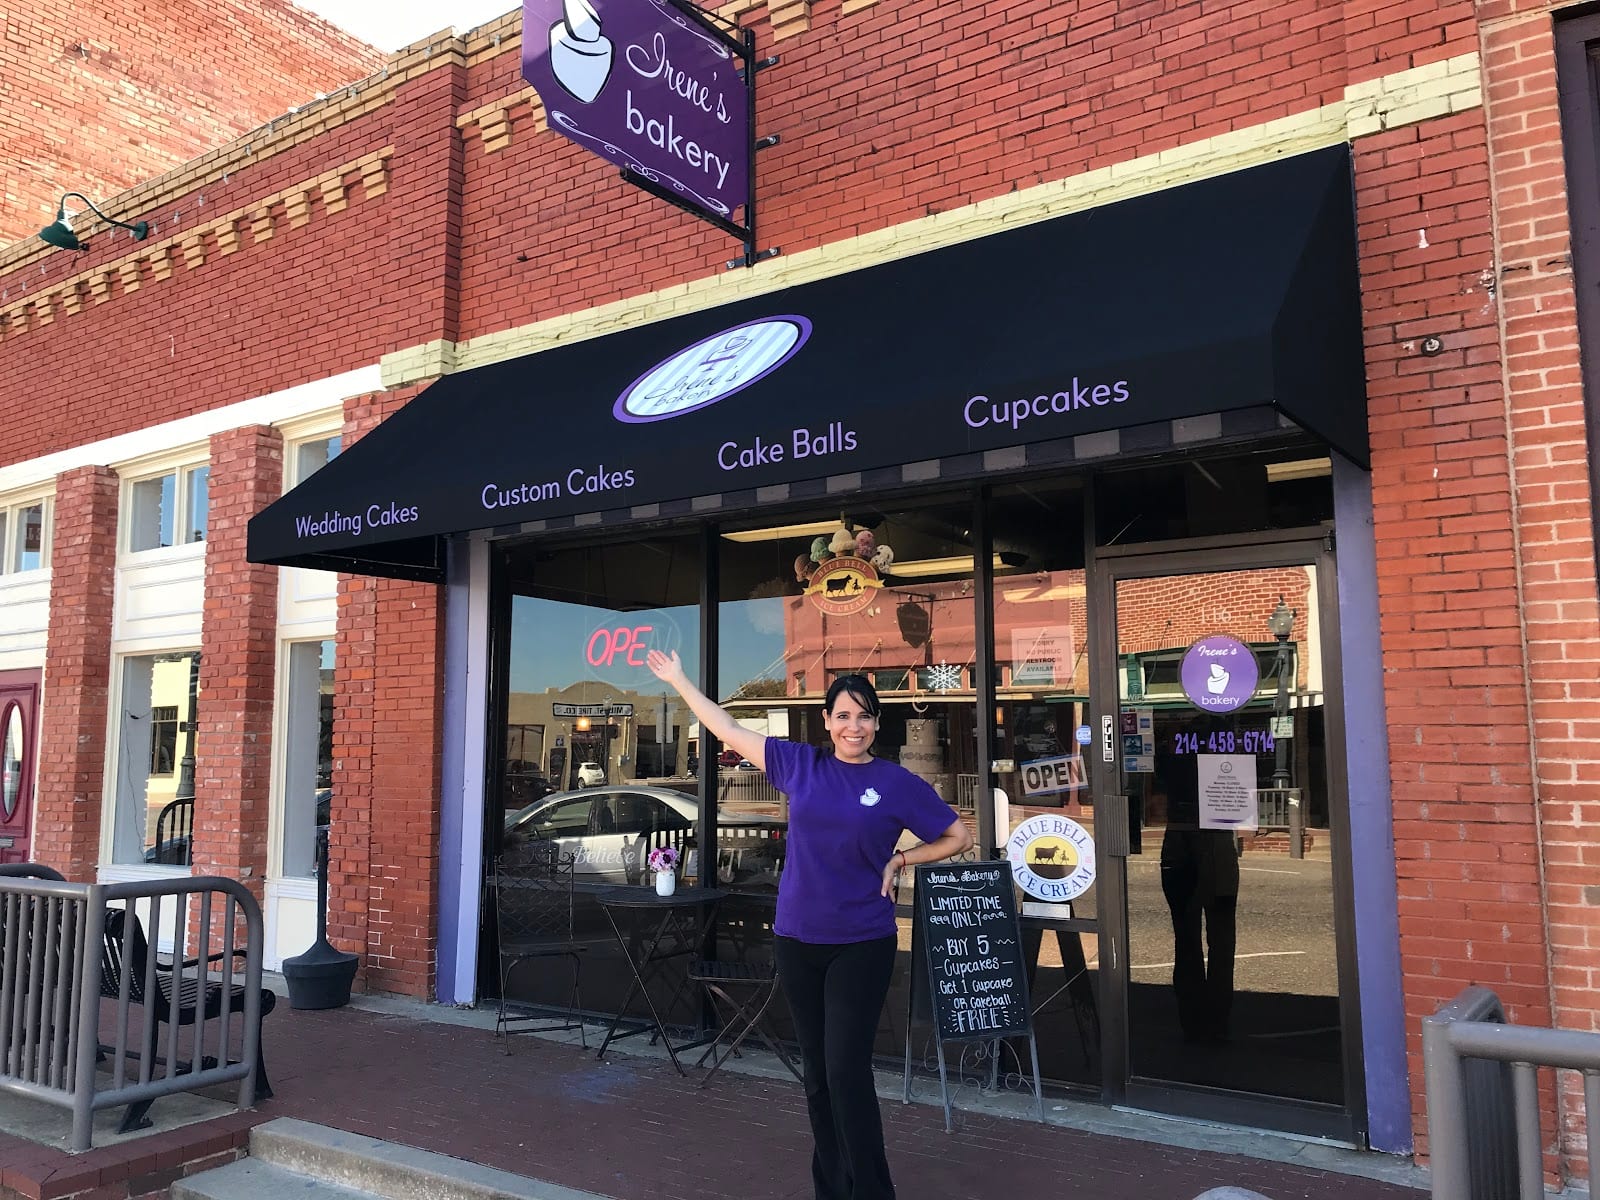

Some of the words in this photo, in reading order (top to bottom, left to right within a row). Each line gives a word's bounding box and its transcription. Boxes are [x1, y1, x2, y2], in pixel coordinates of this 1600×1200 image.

[626, 32, 731, 123] Irene's
[626, 90, 729, 189] bakery
[643, 364, 739, 399] Irene's
[963, 377, 1130, 430] Cupcakes
[717, 436, 784, 471] Cake
[792, 421, 858, 460] Balls
[481, 483, 561, 510] Custom
[567, 464, 635, 496] Cakes
[295, 510, 362, 539] Wedding
[366, 501, 419, 528] Cakes
[1198, 644, 1238, 657] Irene's
[1202, 696, 1240, 707] bakery
[1104, 719, 1112, 751] PULL
[1026, 759, 1084, 790] OPEN
[1013, 819, 1049, 849] BLUE
[1053, 820, 1087, 849] BELL
[1013, 866, 1038, 891] ICE
[1040, 867, 1093, 897] CREAM
[930, 896, 972, 911] LIMITED
[973, 895, 1002, 910] TIME
[952, 910, 982, 929] ONLY
[946, 937, 968, 956] BUY
[977, 934, 990, 955] 5
[944, 956, 1000, 978] Cupcakes
[940, 980, 959, 995] Get
[957, 1007, 1003, 1033] FREE
